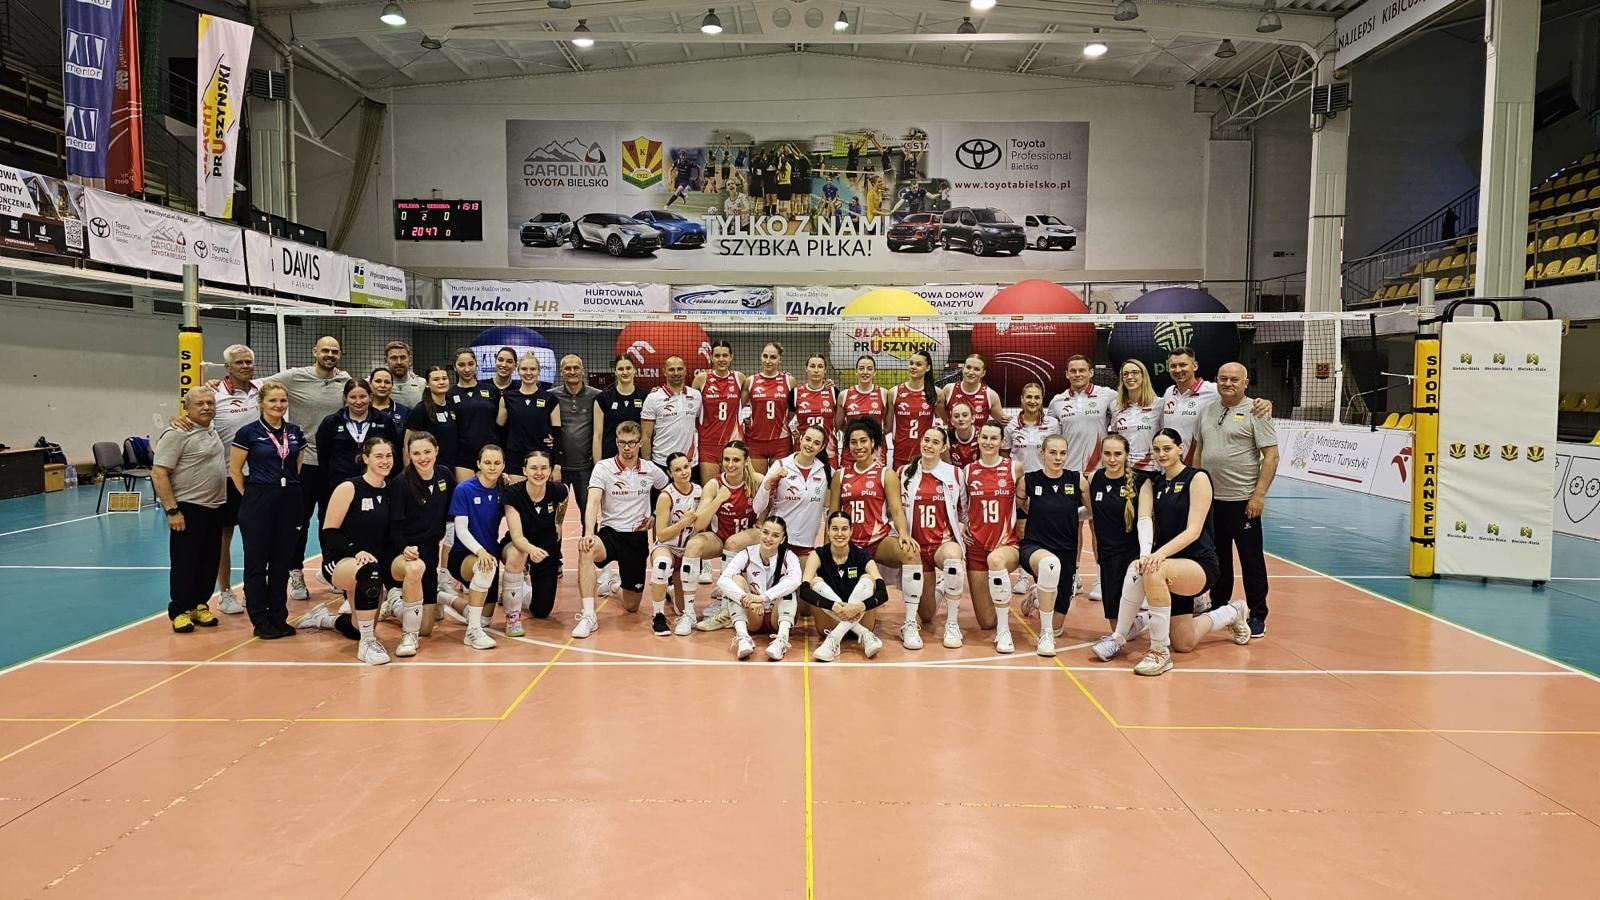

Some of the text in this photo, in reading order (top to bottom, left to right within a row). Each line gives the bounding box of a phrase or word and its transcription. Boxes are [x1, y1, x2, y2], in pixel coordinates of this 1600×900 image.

[1338, 16, 1376, 50] NAJLEPSI
[1011, 138, 1046, 149] Toyota
[1011, 150, 1072, 160] Professional
[523, 164, 608, 177] CAROLINA
[524, 178, 608, 187] TOYOTA BIELSKO
[955, 180, 1071, 190] www.toyotabielsko.pl
[401, 211, 407, 220] 0
[444, 211, 450, 221] 0
[702, 215, 788, 236] TYLKO
[796, 215, 811, 236] Z
[211, 243, 229, 254] Toyota
[720, 239, 872, 256] SZYBKA PIŁKA!
[282, 247, 320, 281] DAVIS
[585, 288, 643, 297] HURTOWNIA
[945, 290, 984, 298] DOMÓW
[456, 295, 529, 311] Abakon
[583, 297, 644, 306] BUDOWLANA
[855, 327, 910, 338] BLACHY
[854, 338, 937, 354] PRUSZYŃSKI
[719, 402, 727, 420] 8
[766, 400, 775, 419] 9
[910, 420, 918, 438] 2
[1316, 435, 1358, 451] Ministerstwo
[1311, 450, 1332, 464] Sportu
[1337, 453, 1369, 470] Turystyki
[850, 500, 864, 524] 15
[919, 505, 936, 528] 16
[981, 500, 999, 523] 19
